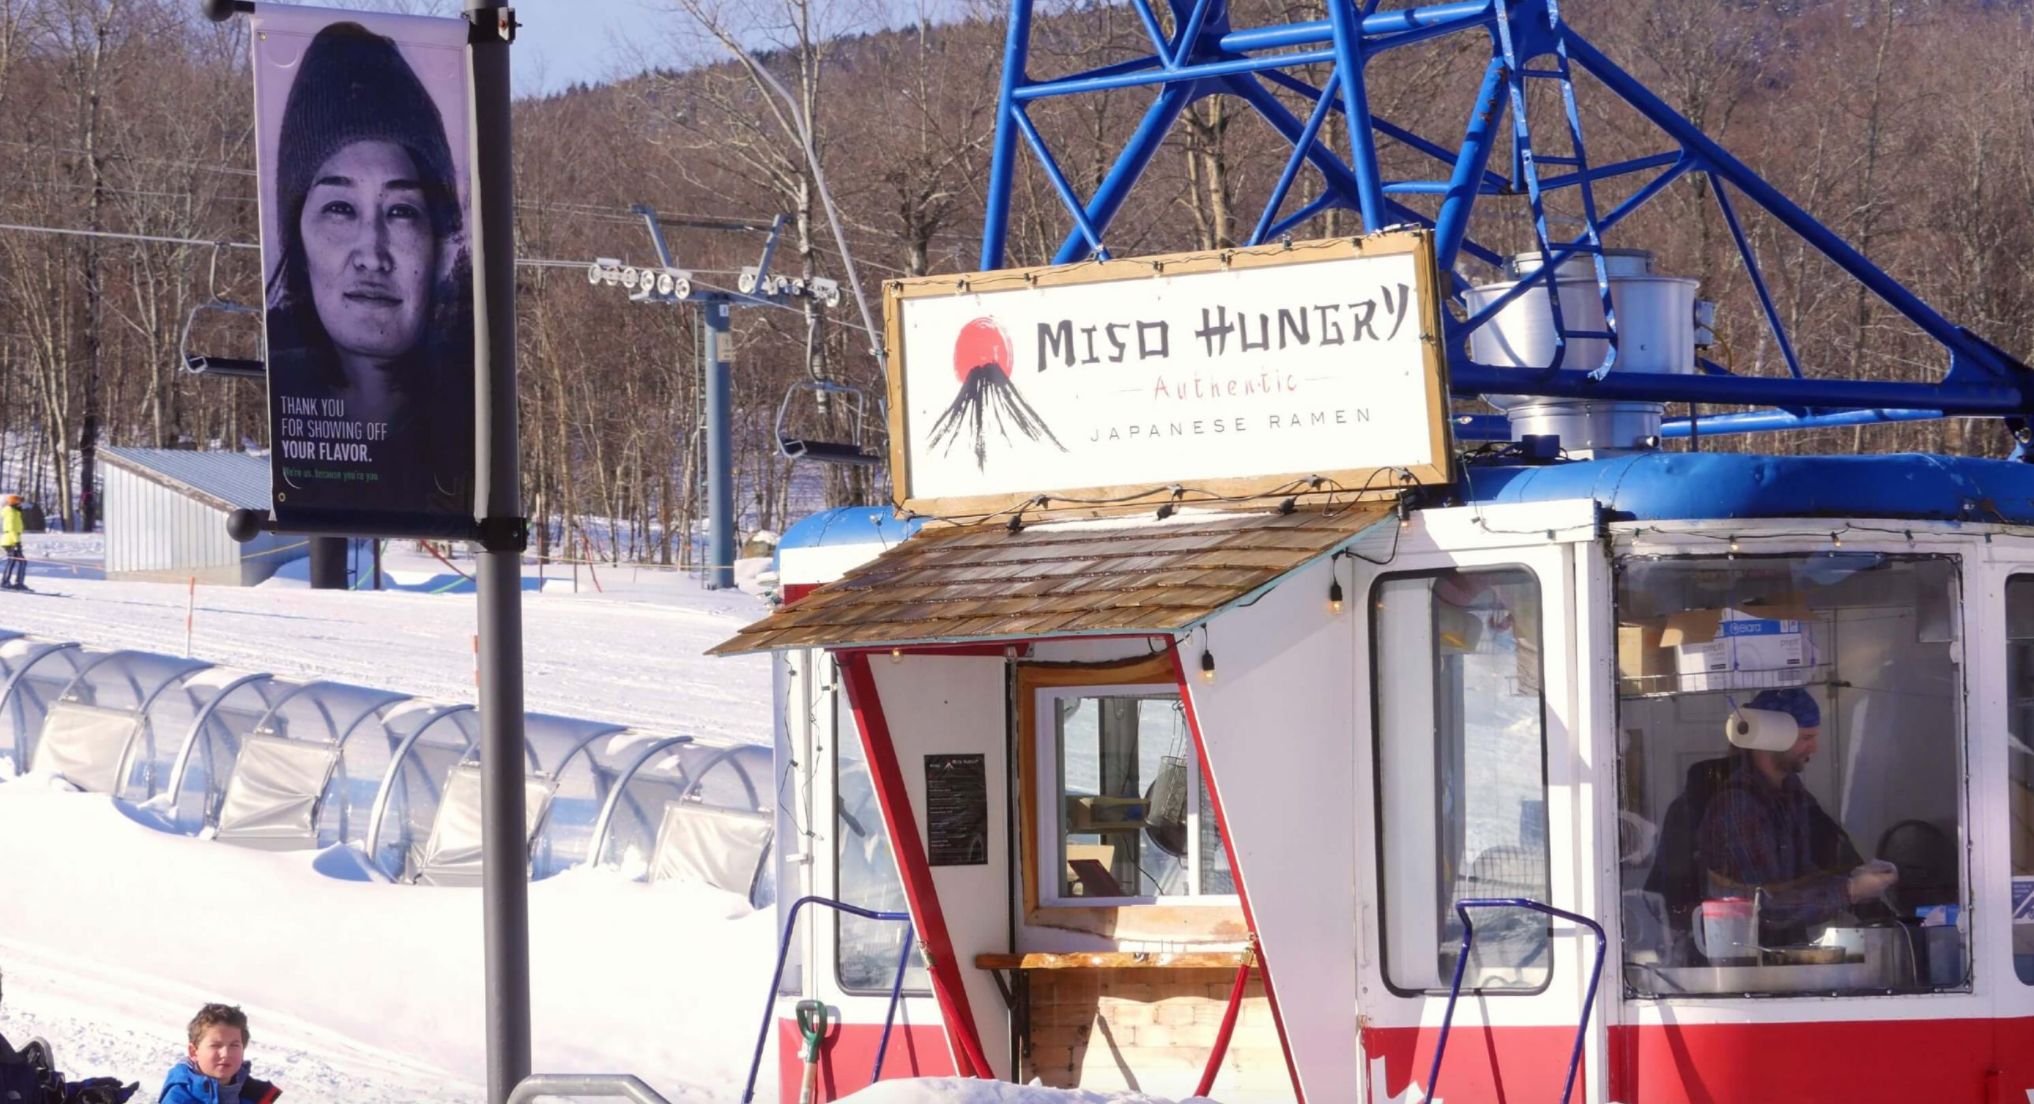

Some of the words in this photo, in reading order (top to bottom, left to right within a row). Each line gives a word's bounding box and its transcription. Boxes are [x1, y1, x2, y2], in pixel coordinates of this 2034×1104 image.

[1037, 319, 1169, 373] MISO
[1194, 283, 1410, 357] HUNGRY
[1154, 370, 1298, 401] Authentic
[280, 396, 318, 416] THANK
[322, 399, 345, 417] YOU
[281, 418, 304, 437] FOR
[308, 420, 363, 440] SHOWING
[366, 423, 388, 441] OFF
[1090, 417, 1248, 443] JAPANESE
[1269, 408, 1371, 429] RAMEN
[281, 440, 316, 460] YOUR
[319, 442, 372, 462] FLAVOR.
[315, 469, 341, 479] because
